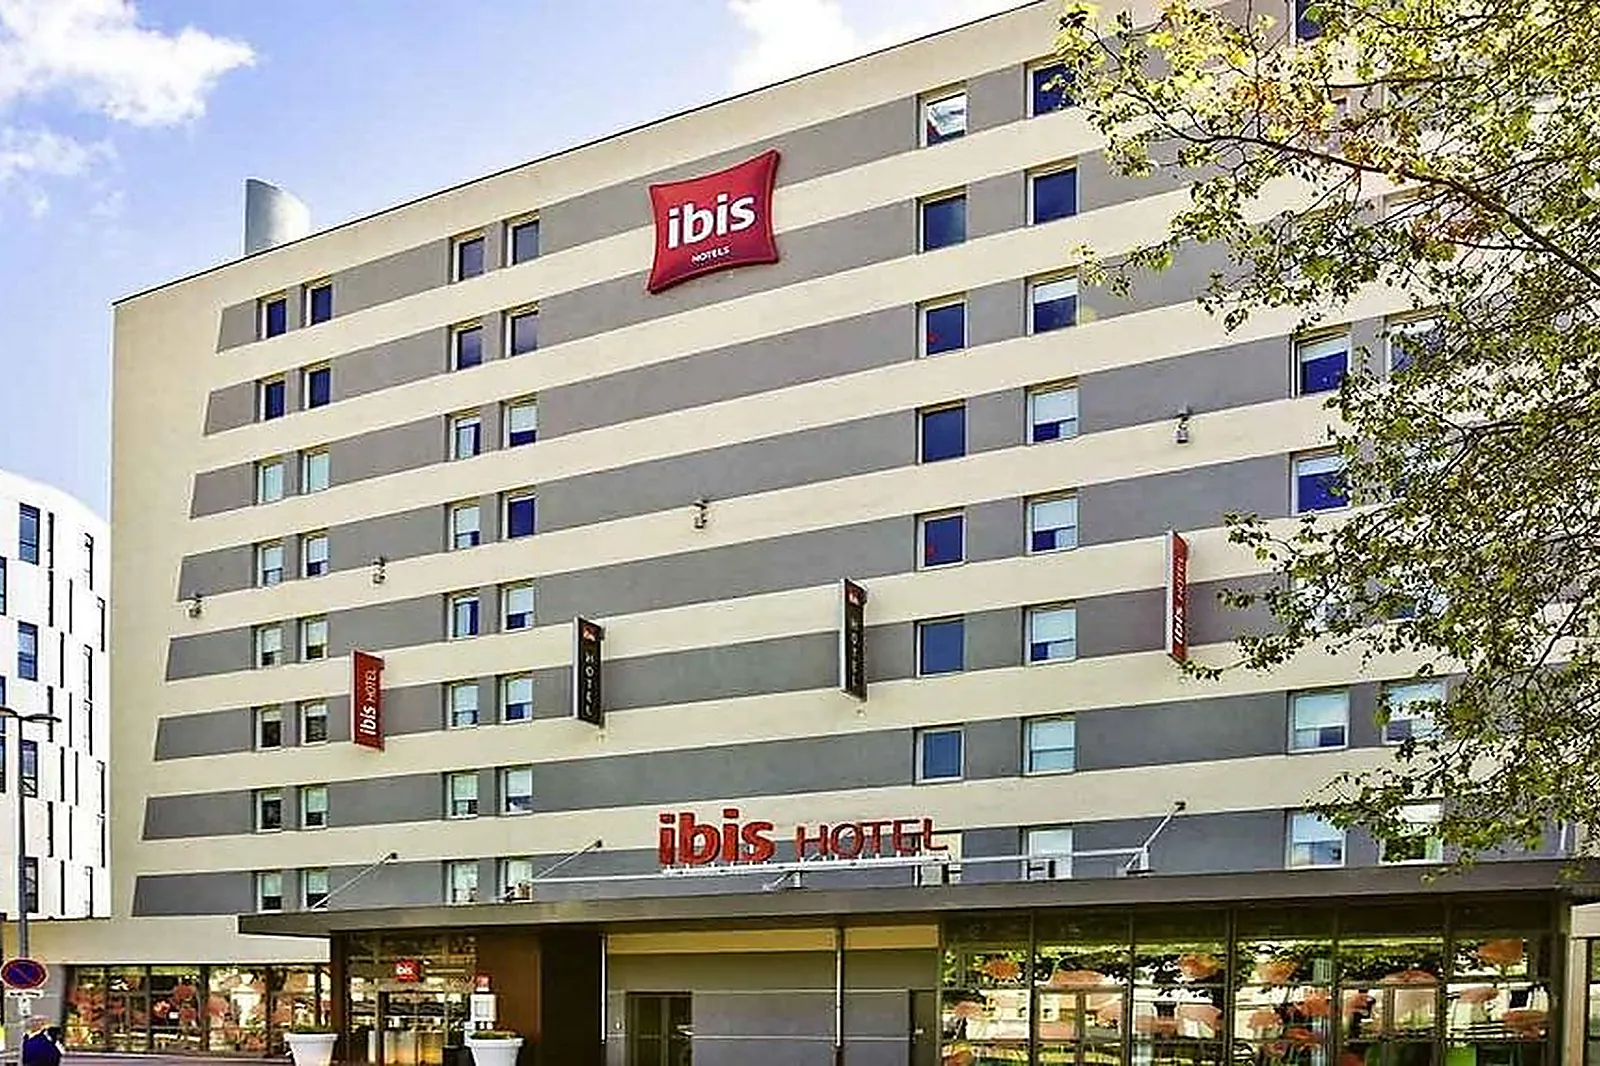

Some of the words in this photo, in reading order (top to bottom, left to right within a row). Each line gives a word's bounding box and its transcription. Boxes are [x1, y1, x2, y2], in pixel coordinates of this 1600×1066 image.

[668, 194, 756, 249] ibis
[692, 246, 730, 263] HOTELS
[1174, 607, 1184, 645] ibis
[365, 669, 377, 702] HOTEL
[585, 653, 595, 716] HOTEL
[360, 705, 377, 735] ibis
[659, 808, 776, 865] ibis
[796, 818, 949, 857] HOTEL
